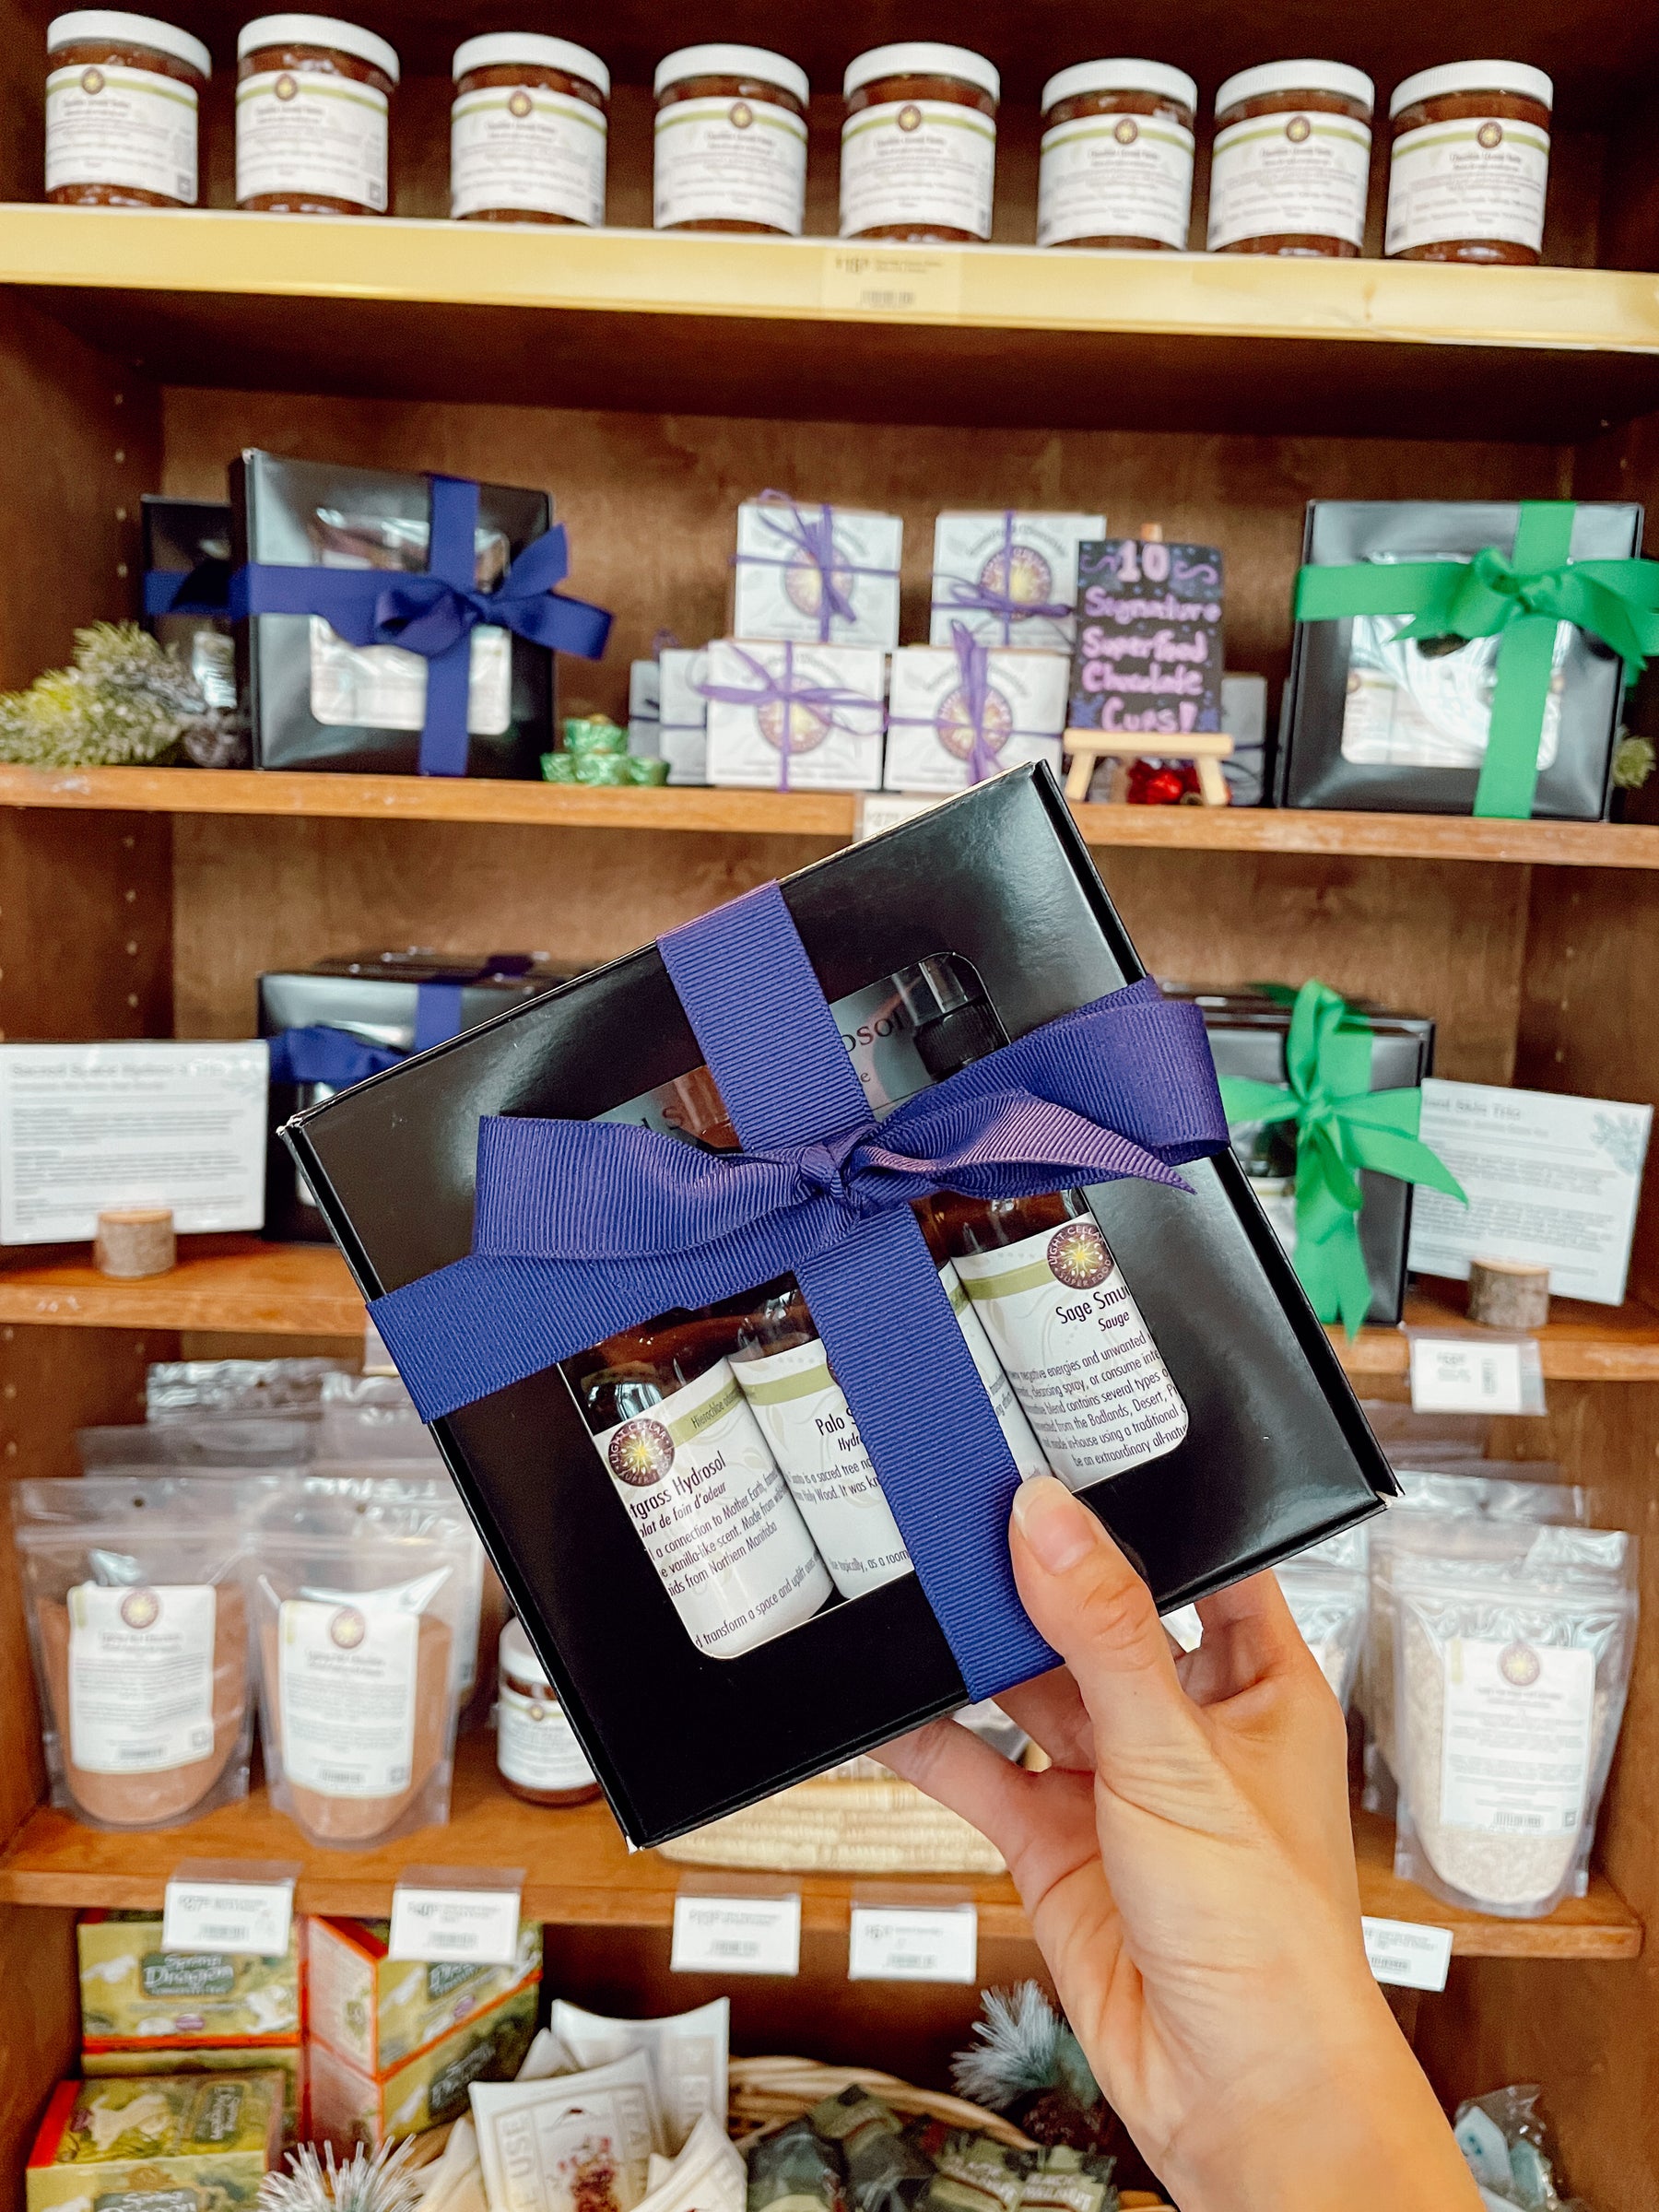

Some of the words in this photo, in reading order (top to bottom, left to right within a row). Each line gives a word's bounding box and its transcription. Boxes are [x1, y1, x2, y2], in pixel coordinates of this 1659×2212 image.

[1117, 539, 1171, 582] 10
[1101, 696, 1197, 734] Cups!
[1048, 1232, 1065, 1265] LIGHT
[1067, 1225, 1105, 1244] CELLA
[1059, 1272, 1088, 1287] SUPER
[1092, 1259, 1112, 1283] FOOD
[1055, 1301, 1092, 1324] Sage
[1098, 1312, 1130, 1332] Sauge
[1046, 1359, 1082, 1377] energies
[1081, 1349, 1100, 1367] and
[1100, 1330, 1147, 1360] unwanted
[1062, 1380, 1089, 1395] spray,
[1089, 1374, 1100, 1387] or
[1101, 1359, 1142, 1382] consume
[1066, 1394, 1100, 1412] contains
[1101, 1380, 1134, 1403] several
[1135, 1371, 1161, 1394] types
[815, 1413, 845, 1436] Palo
[1074, 1416, 1088, 1430] the
[1088, 1404, 1134, 1427] Badlands,
[1132, 1391, 1168, 1412] Desert,
[1100, 1430, 1124, 1442] using
[1124, 1427, 1132, 1437] a
[1132, 1403, 1179, 1433] traditional
[611, 1430, 625, 1464] LIGHT
[629, 1421, 666, 1440] CELLAR
[838, 1432, 860, 1452] Hydr
[1084, 1455, 1095, 1466] an
[1095, 1441, 1151, 1463] extraordinary
[629, 1488, 672, 1520] tgrass
[672, 1450, 726, 1496] Hydrosol
[817, 1464, 842, 1483] sacred
[841, 1462, 860, 1477] tree
[839, 1484, 847, 1497] It
[848, 1480, 867, 1494] was
[659, 1514, 672, 1529] de
[673, 1503, 692, 1521] foin
[694, 1481, 727, 1510] d'odeur
[655, 1548, 664, 1559] a
[665, 1524, 712, 1554] connection
[712, 1515, 723, 1527] to
[722, 1496, 750, 1520] Mother
[669, 1541, 717, 1572] vanilla-like
[716, 1525, 742, 1548] scent.
[741, 1512, 762, 1531] Made
[759, 1499, 776, 1516] from
[684, 1570, 710, 1589] from
[708, 1545, 747, 1575] Northern
[745, 1521, 778, 1552] Manitoba
[867, 1558, 877, 1569] as
[878, 1557, 886, 1567] a
[886, 1549, 910, 1564] room
[702, 1614, 747, 1645] transform
[747, 1609, 756, 1620] a
[756, 1593, 779, 1615] space
[778, 1577, 793, 1598] and
